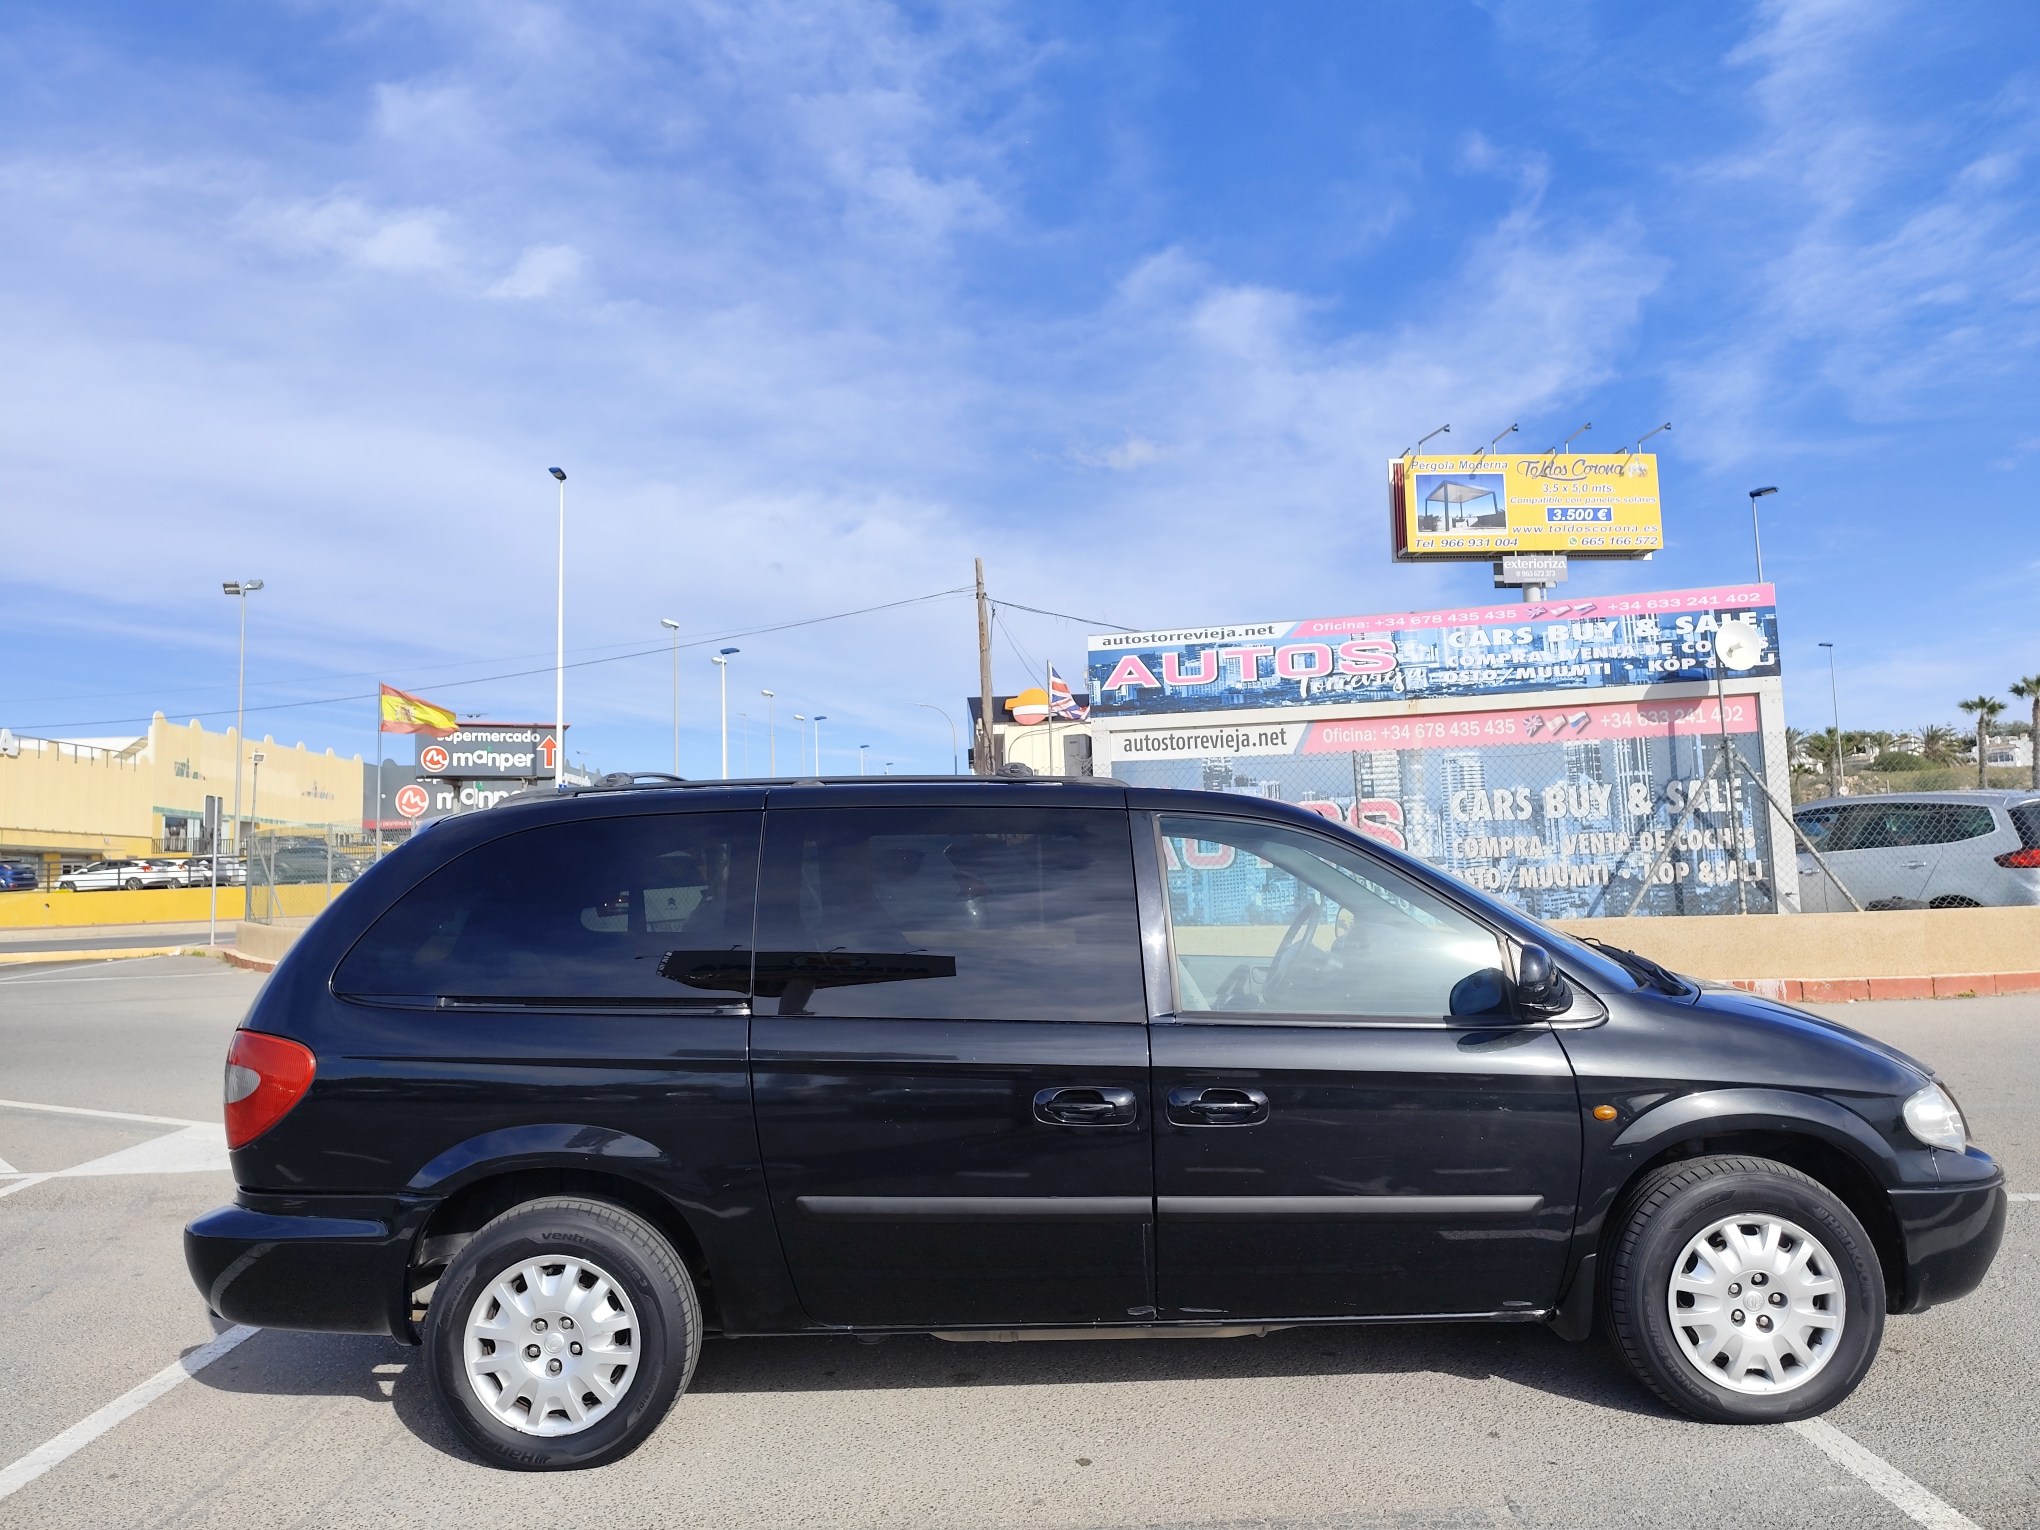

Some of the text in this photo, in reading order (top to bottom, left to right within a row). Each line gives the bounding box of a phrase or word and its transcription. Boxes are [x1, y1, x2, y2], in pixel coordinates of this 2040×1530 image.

[1459, 460, 1508, 470] Moderna
[1543, 484, 1559, 493] 3,5
[1572, 484, 1588, 493] 5,0
[1510, 496, 1563, 504] Compatible
[1552, 508, 1608, 521] 3.500 €
[1512, 525, 1658, 533] www.toldoscorona.es
[1415, 538, 1518, 548] Tel. 966 931 004
[1581, 536, 1658, 546] 665 166 572
[1607, 592, 1761, 612] +34 633 241 402
[1312, 609, 1517, 632] Oficina: +34 678 435 435
[1102, 624, 1275, 646] autostorrevieja.net
[1449, 626, 1534, 648] CARS
[1547, 620, 1619, 643] BUY
[1635, 618, 1661, 638] &
[1100, 638, 1399, 691] AUTOS
[1448, 650, 1545, 667] COMPRA
[1644, 642, 1674, 656] DE
[1648, 655, 1697, 672] KÖP
[1600, 705, 1744, 728] +34 633 241 402
[1123, 727, 1287, 753] autostorrevieja.net
[1322, 718, 1515, 744] Oficina: +34 678 435 435
[452, 749, 535, 772] manper
[1451, 786, 1534, 822] CARS
[1544, 783, 1613, 819] BUY
[1626, 782, 1654, 816] &
[1452, 834, 1545, 859] COMPRA
[1561, 831, 1631, 855] VENTA
[1640, 830, 1667, 852] DE
